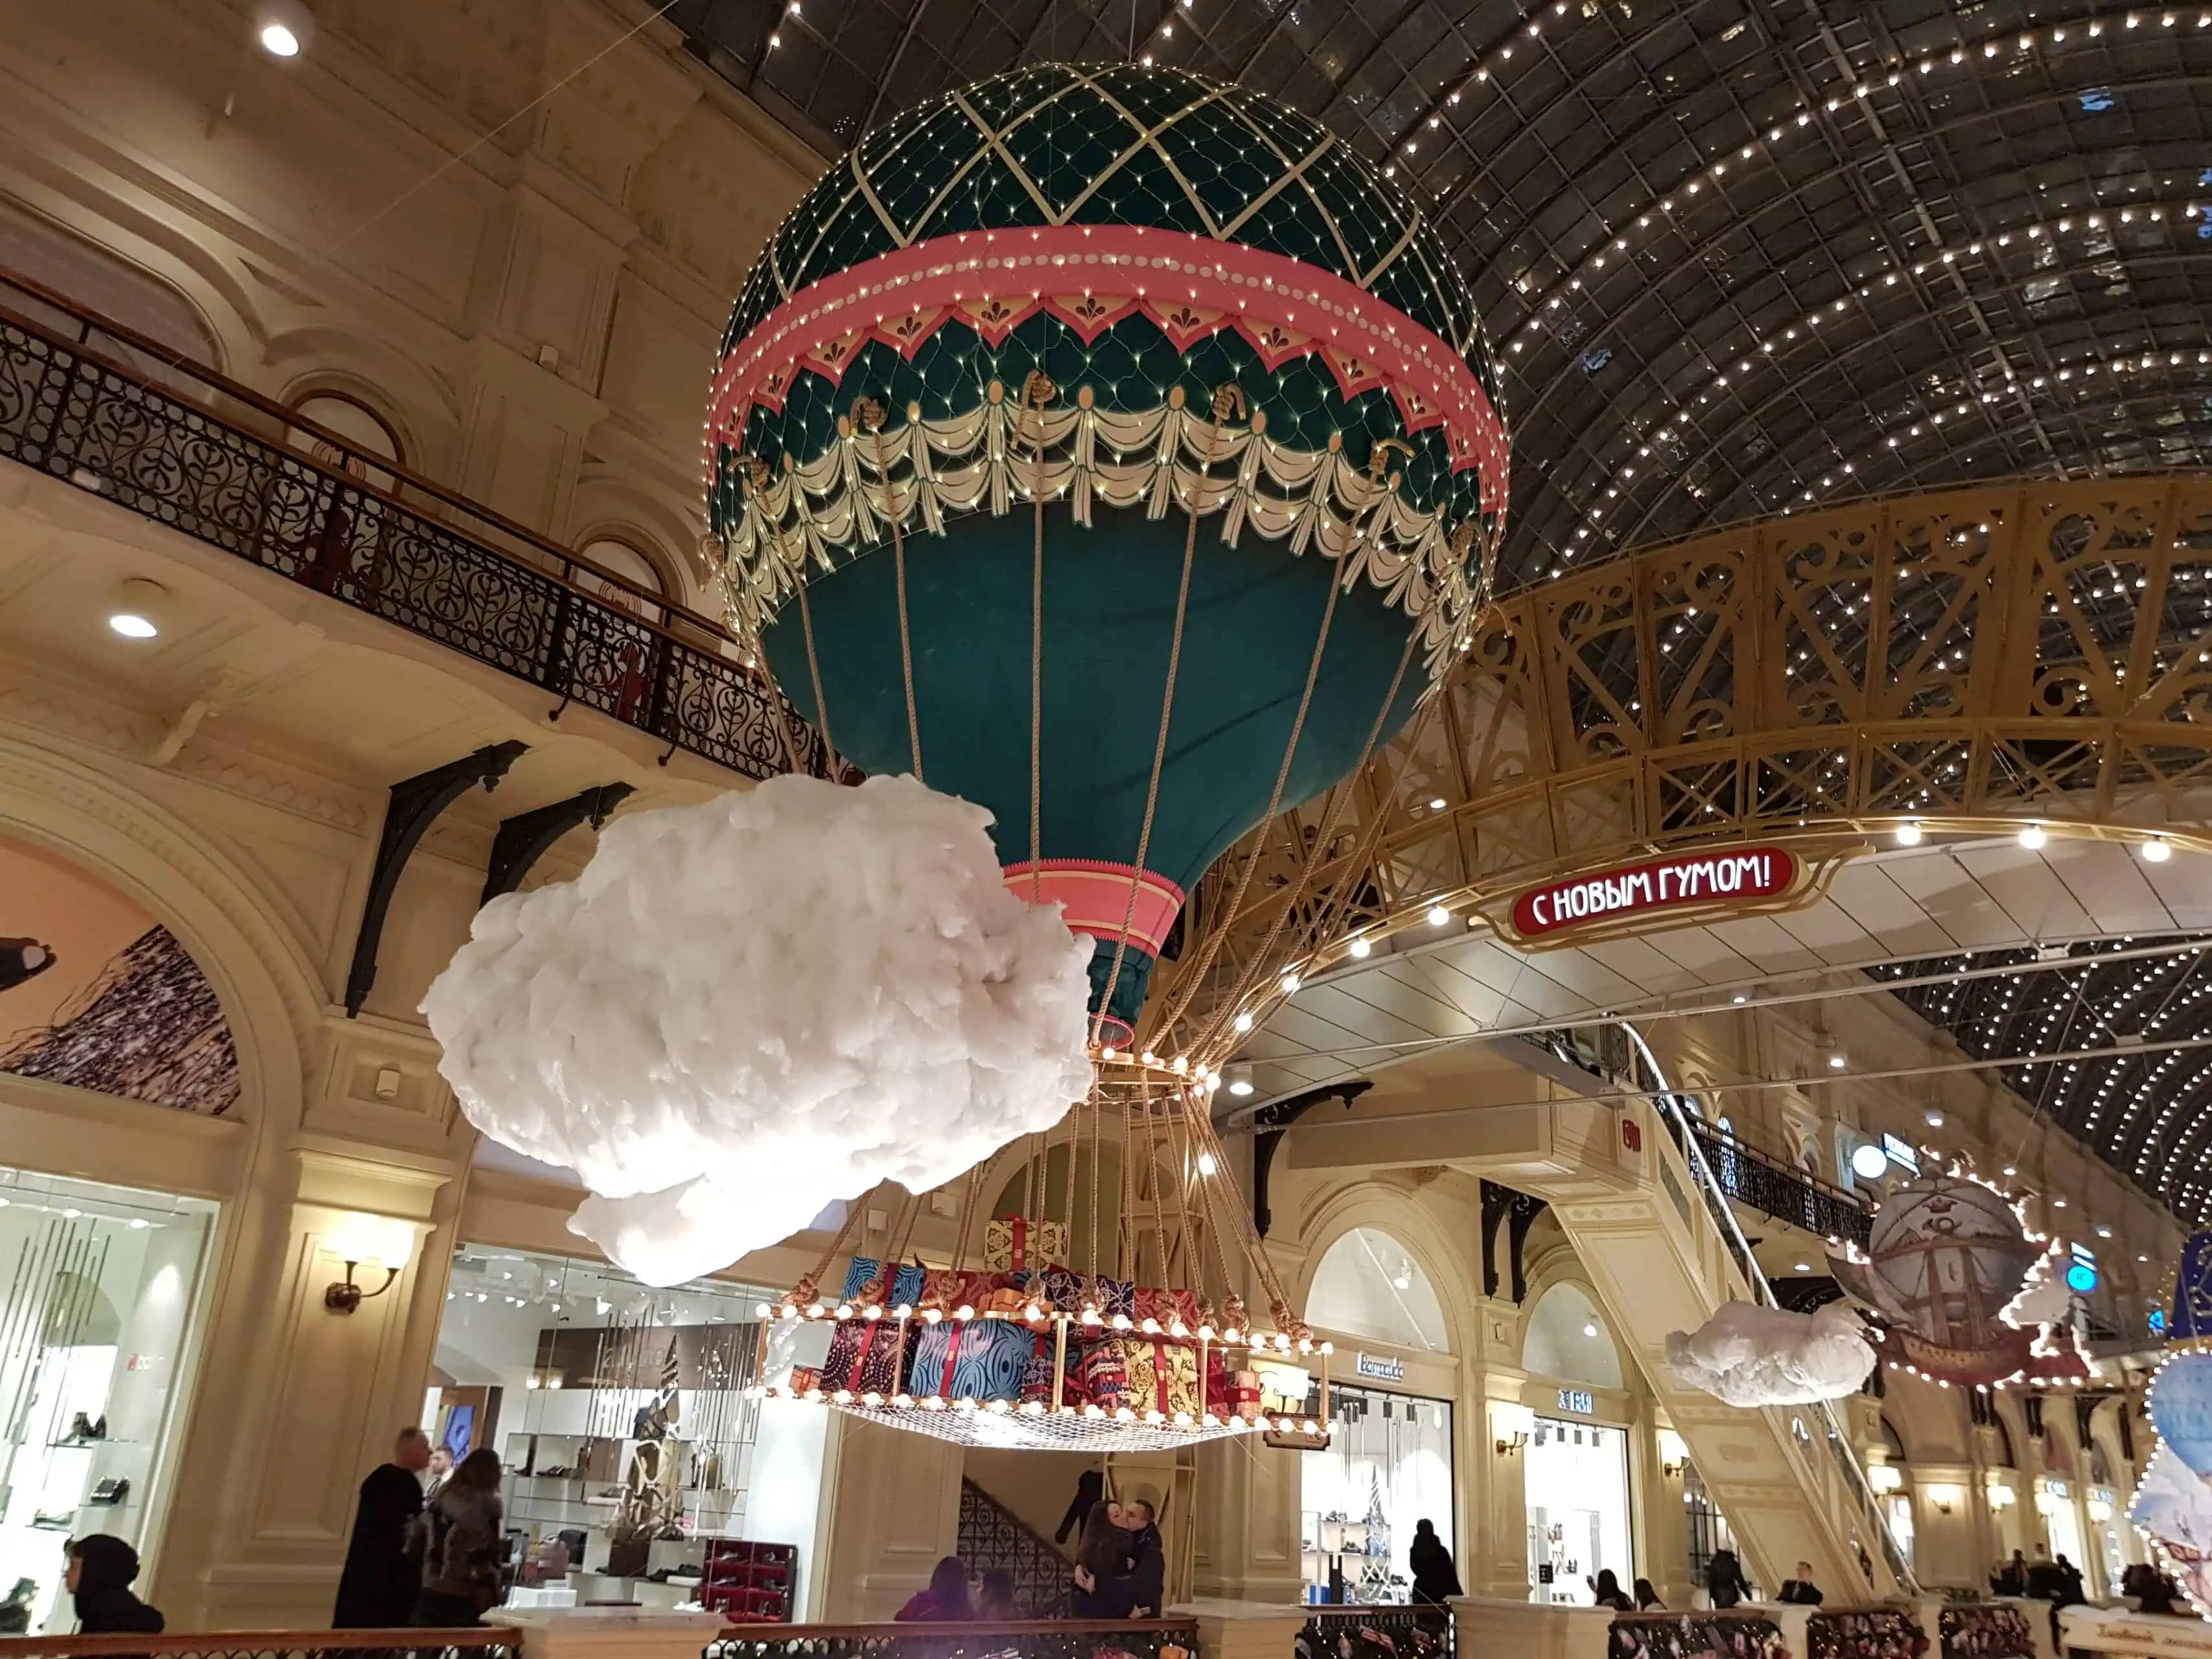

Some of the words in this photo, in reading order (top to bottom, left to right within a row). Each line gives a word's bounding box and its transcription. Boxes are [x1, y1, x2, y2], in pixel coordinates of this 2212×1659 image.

[1533, 896, 1549, 925] С
[1554, 872, 1653, 921] НОВЫМ
[1659, 855, 1770, 900] ГУМОМ!
